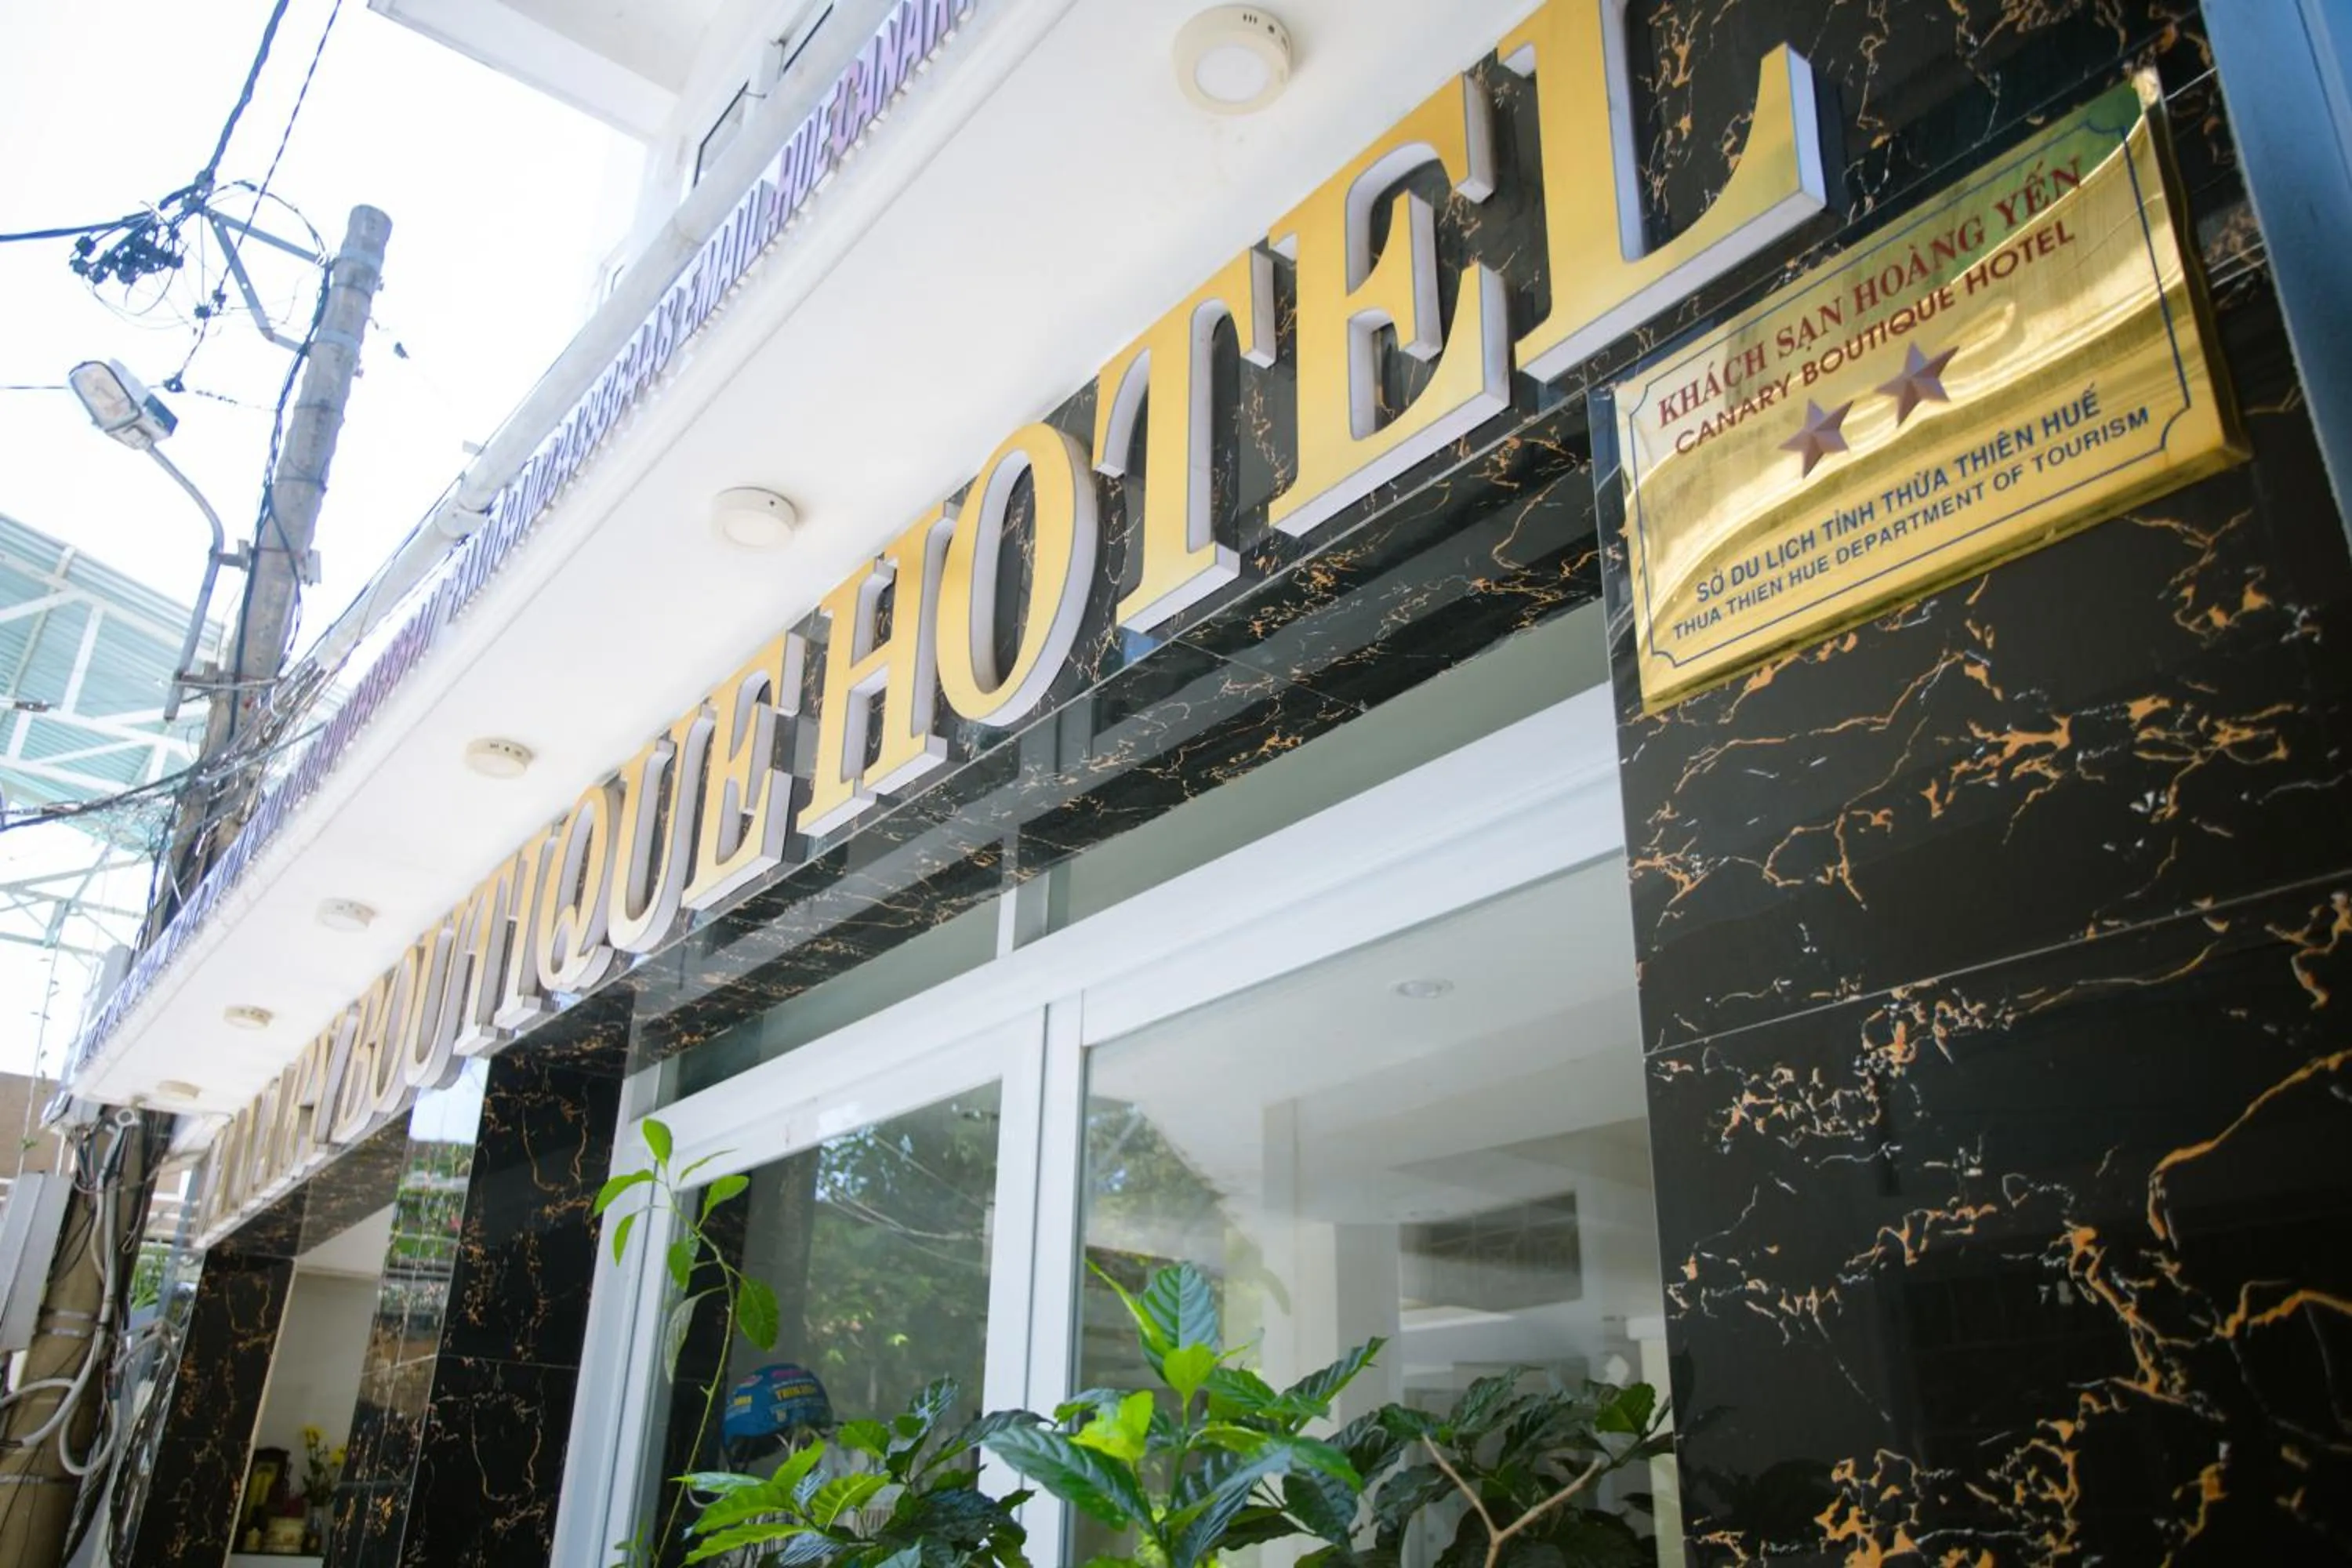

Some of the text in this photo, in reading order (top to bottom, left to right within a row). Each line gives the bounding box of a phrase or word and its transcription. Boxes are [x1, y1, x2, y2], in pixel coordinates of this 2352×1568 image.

[1657, 155, 2084, 429] KHÁCH SẠN HOÀNG YẾN
[1675, 220, 2076, 455] CANARY BOUTIQUE HOTEL
[329, 630, 806, 1147] BOUTIQUE
[797, 0, 1827, 837] HOTEL
[1673, 405, 2150, 640] THUA THIEN HUE DEPARTMENT OF TOURISM
[1696, 564, 1725, 603] SỞ
[1730, 556, 1760, 587] DU
[1766, 529, 1816, 568] LỊCH
[1881, 466, 1950, 514] THỪA
[1954, 426, 2034, 479] THIÊN
[2041, 381, 2101, 439] HUẾ
